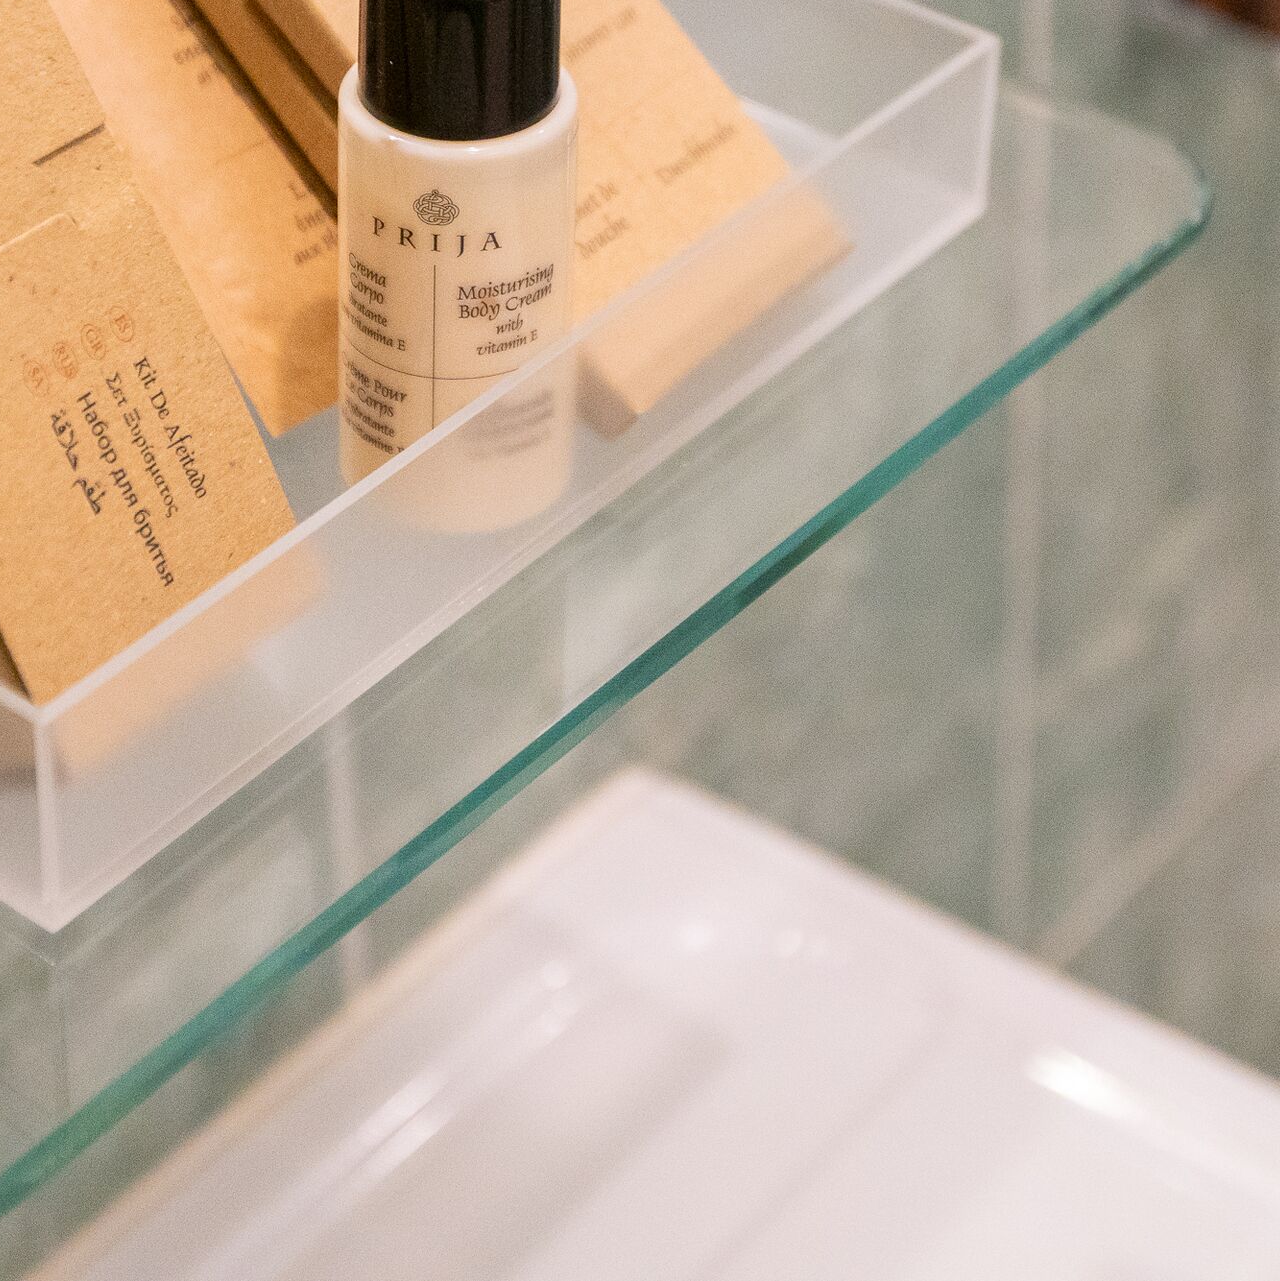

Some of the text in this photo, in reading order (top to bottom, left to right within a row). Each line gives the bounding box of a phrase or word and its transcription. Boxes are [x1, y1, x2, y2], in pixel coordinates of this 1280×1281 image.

[372, 215, 502, 258] PRIJA
[348, 252, 387, 288] Crema
[457, 263, 555, 302] Moisturising
[349, 272, 385, 305] Corpo
[458, 283, 553, 321] Body Cream
[476, 329, 539, 356] vitamin E
[495, 313, 524, 336] with
[396, 338, 406, 352] E
[114, 313, 207, 500] ES Kit De Afeitado
[357, 386, 395, 419] Corps
[373, 377, 407, 403] Pour
[105, 371, 128, 408] Σετ
[123, 407, 179, 519] Ξυρίσματος
[55, 343, 175, 588] RUS Набор для бритья
